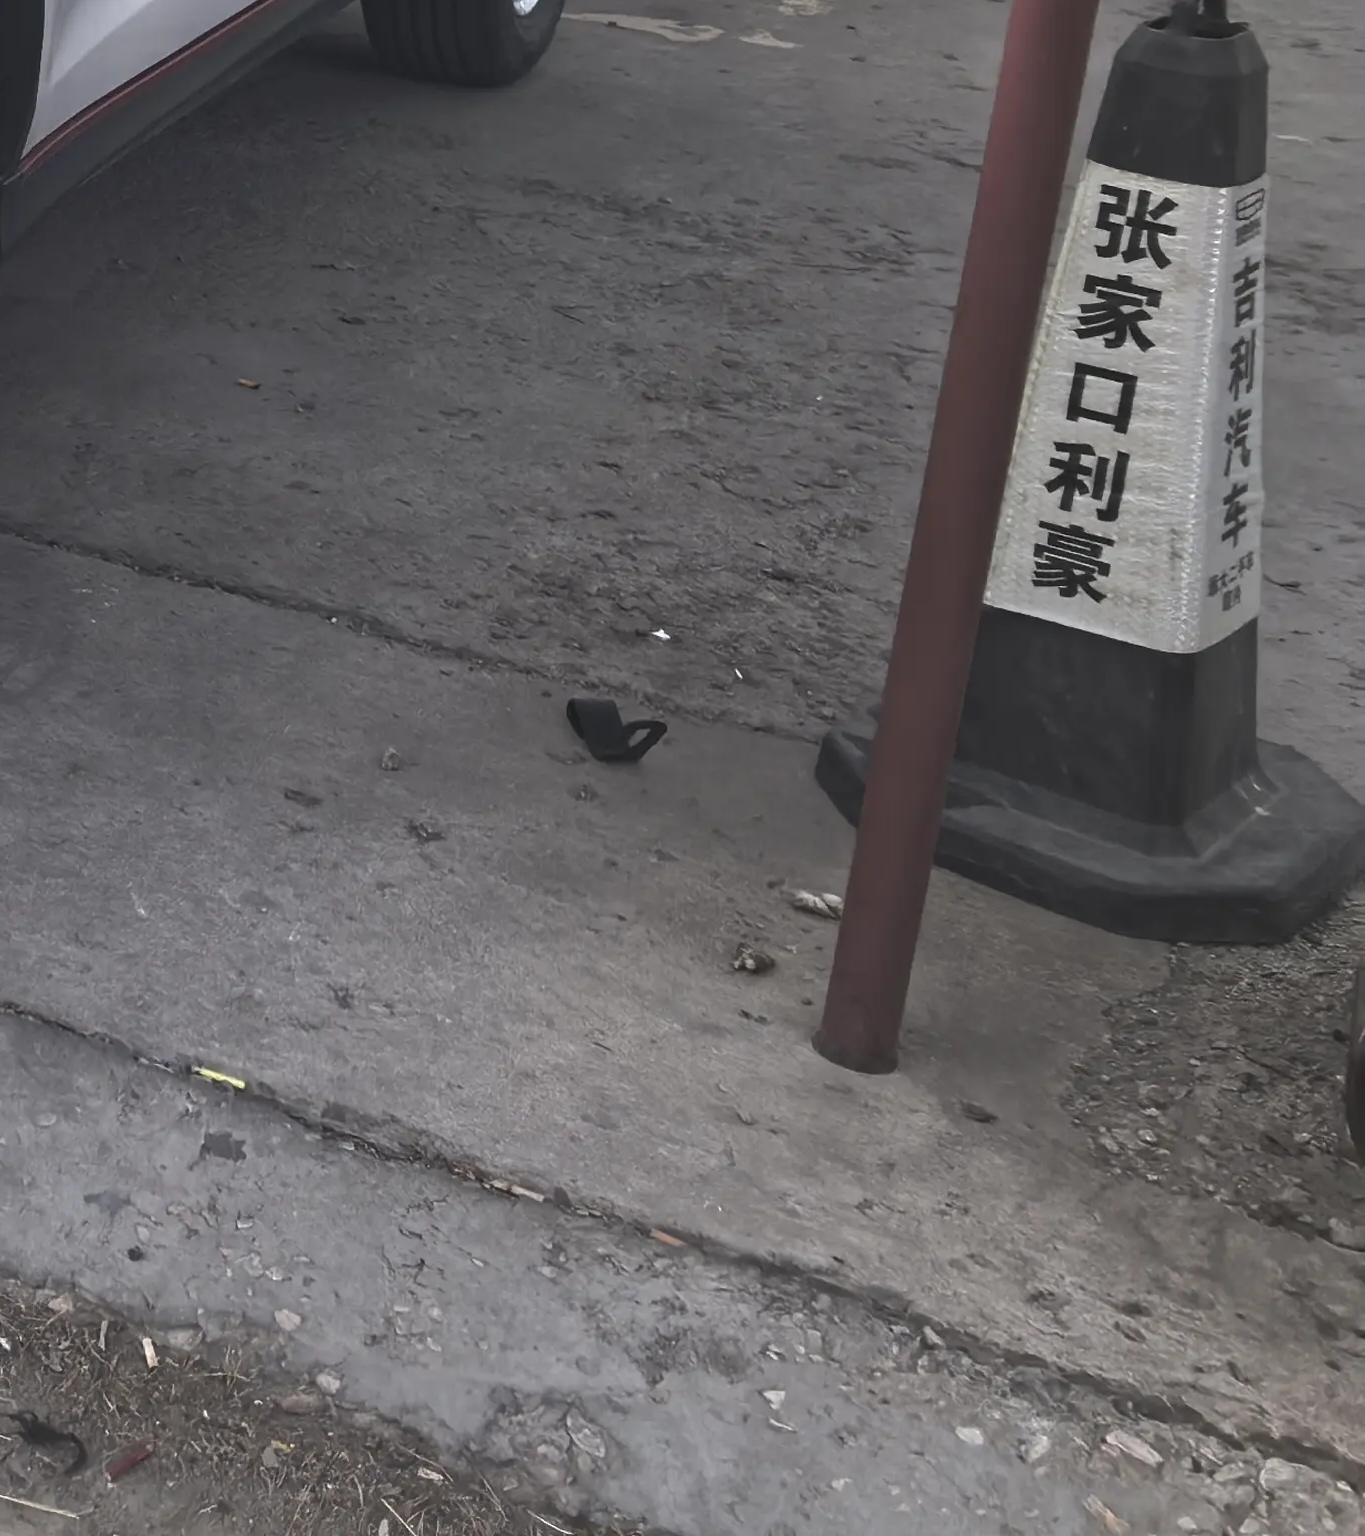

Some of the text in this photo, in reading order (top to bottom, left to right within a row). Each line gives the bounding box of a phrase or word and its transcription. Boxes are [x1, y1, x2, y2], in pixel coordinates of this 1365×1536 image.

[1030, 183, 1178, 603] 张家口利豪
[1221, 257, 1261, 548] 吉利汽车
